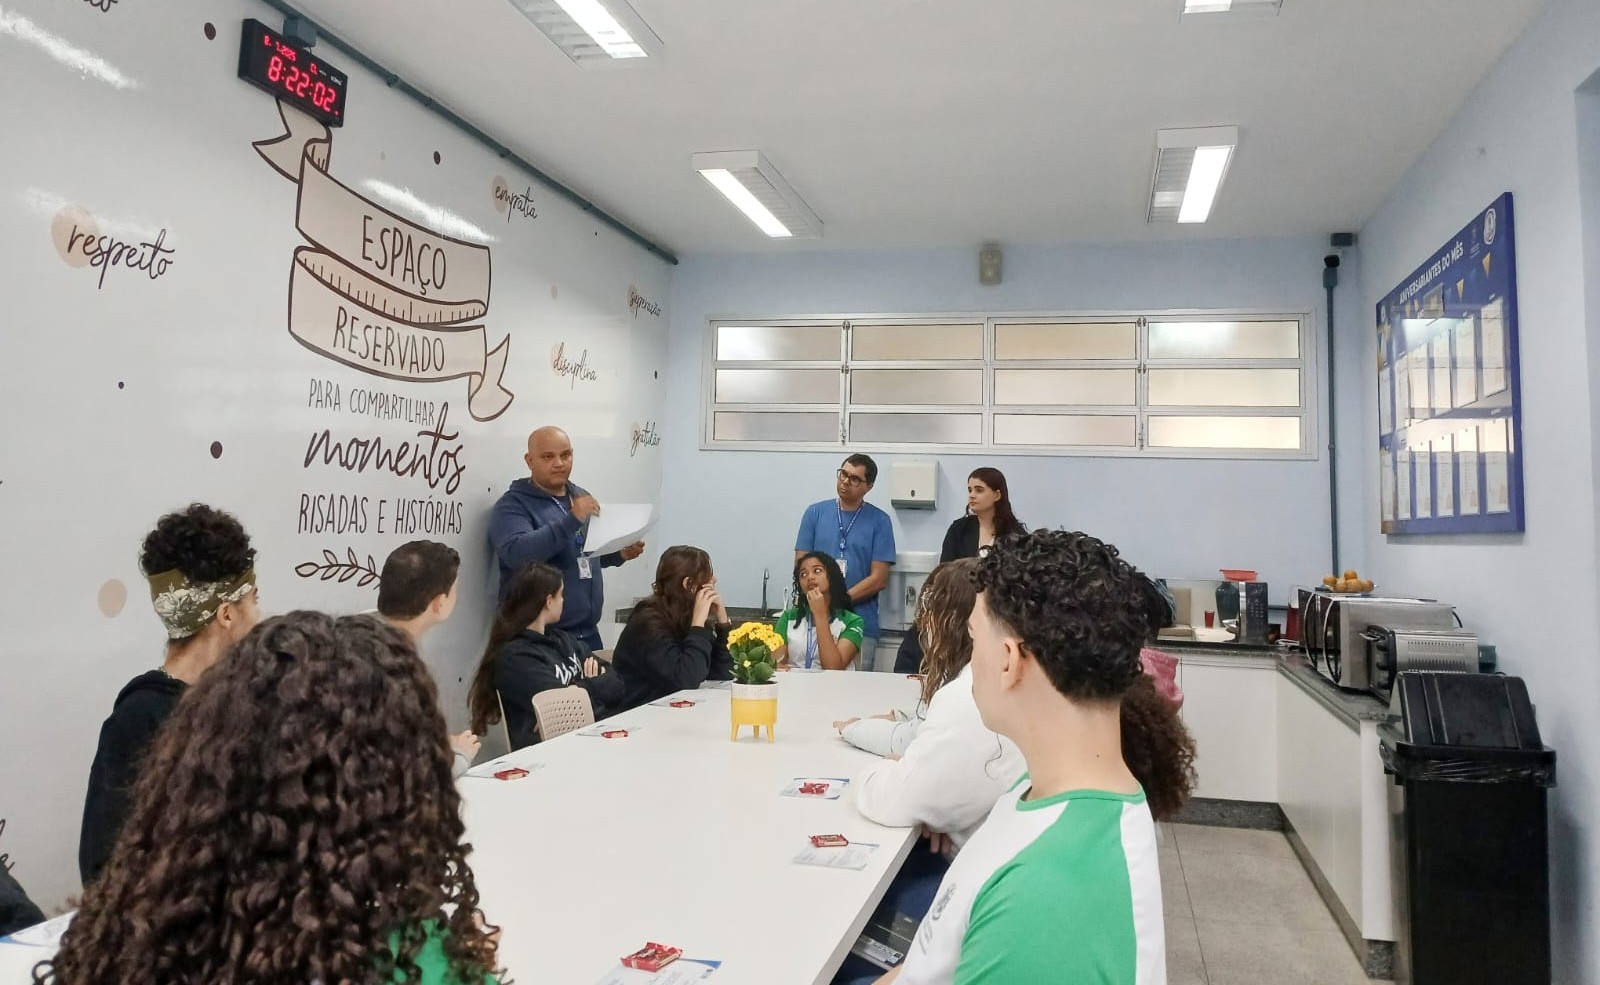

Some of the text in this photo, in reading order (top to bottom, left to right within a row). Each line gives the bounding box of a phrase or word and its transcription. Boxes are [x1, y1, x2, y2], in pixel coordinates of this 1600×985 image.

[495, 186, 538, 223] empatia
[67, 225, 175, 289] respeito
[361, 214, 447, 296] ESPAÇO
[1441, 253, 1450, 271] DO
[332, 306, 445, 374] RESERVADO
[553, 342, 597, 390] disciplina
[308, 378, 435, 427] PARA COMPARTILHAR
[303, 401, 466, 495] momentos
[298, 493, 463, 535] RISADAS E HISTÓRIAS
